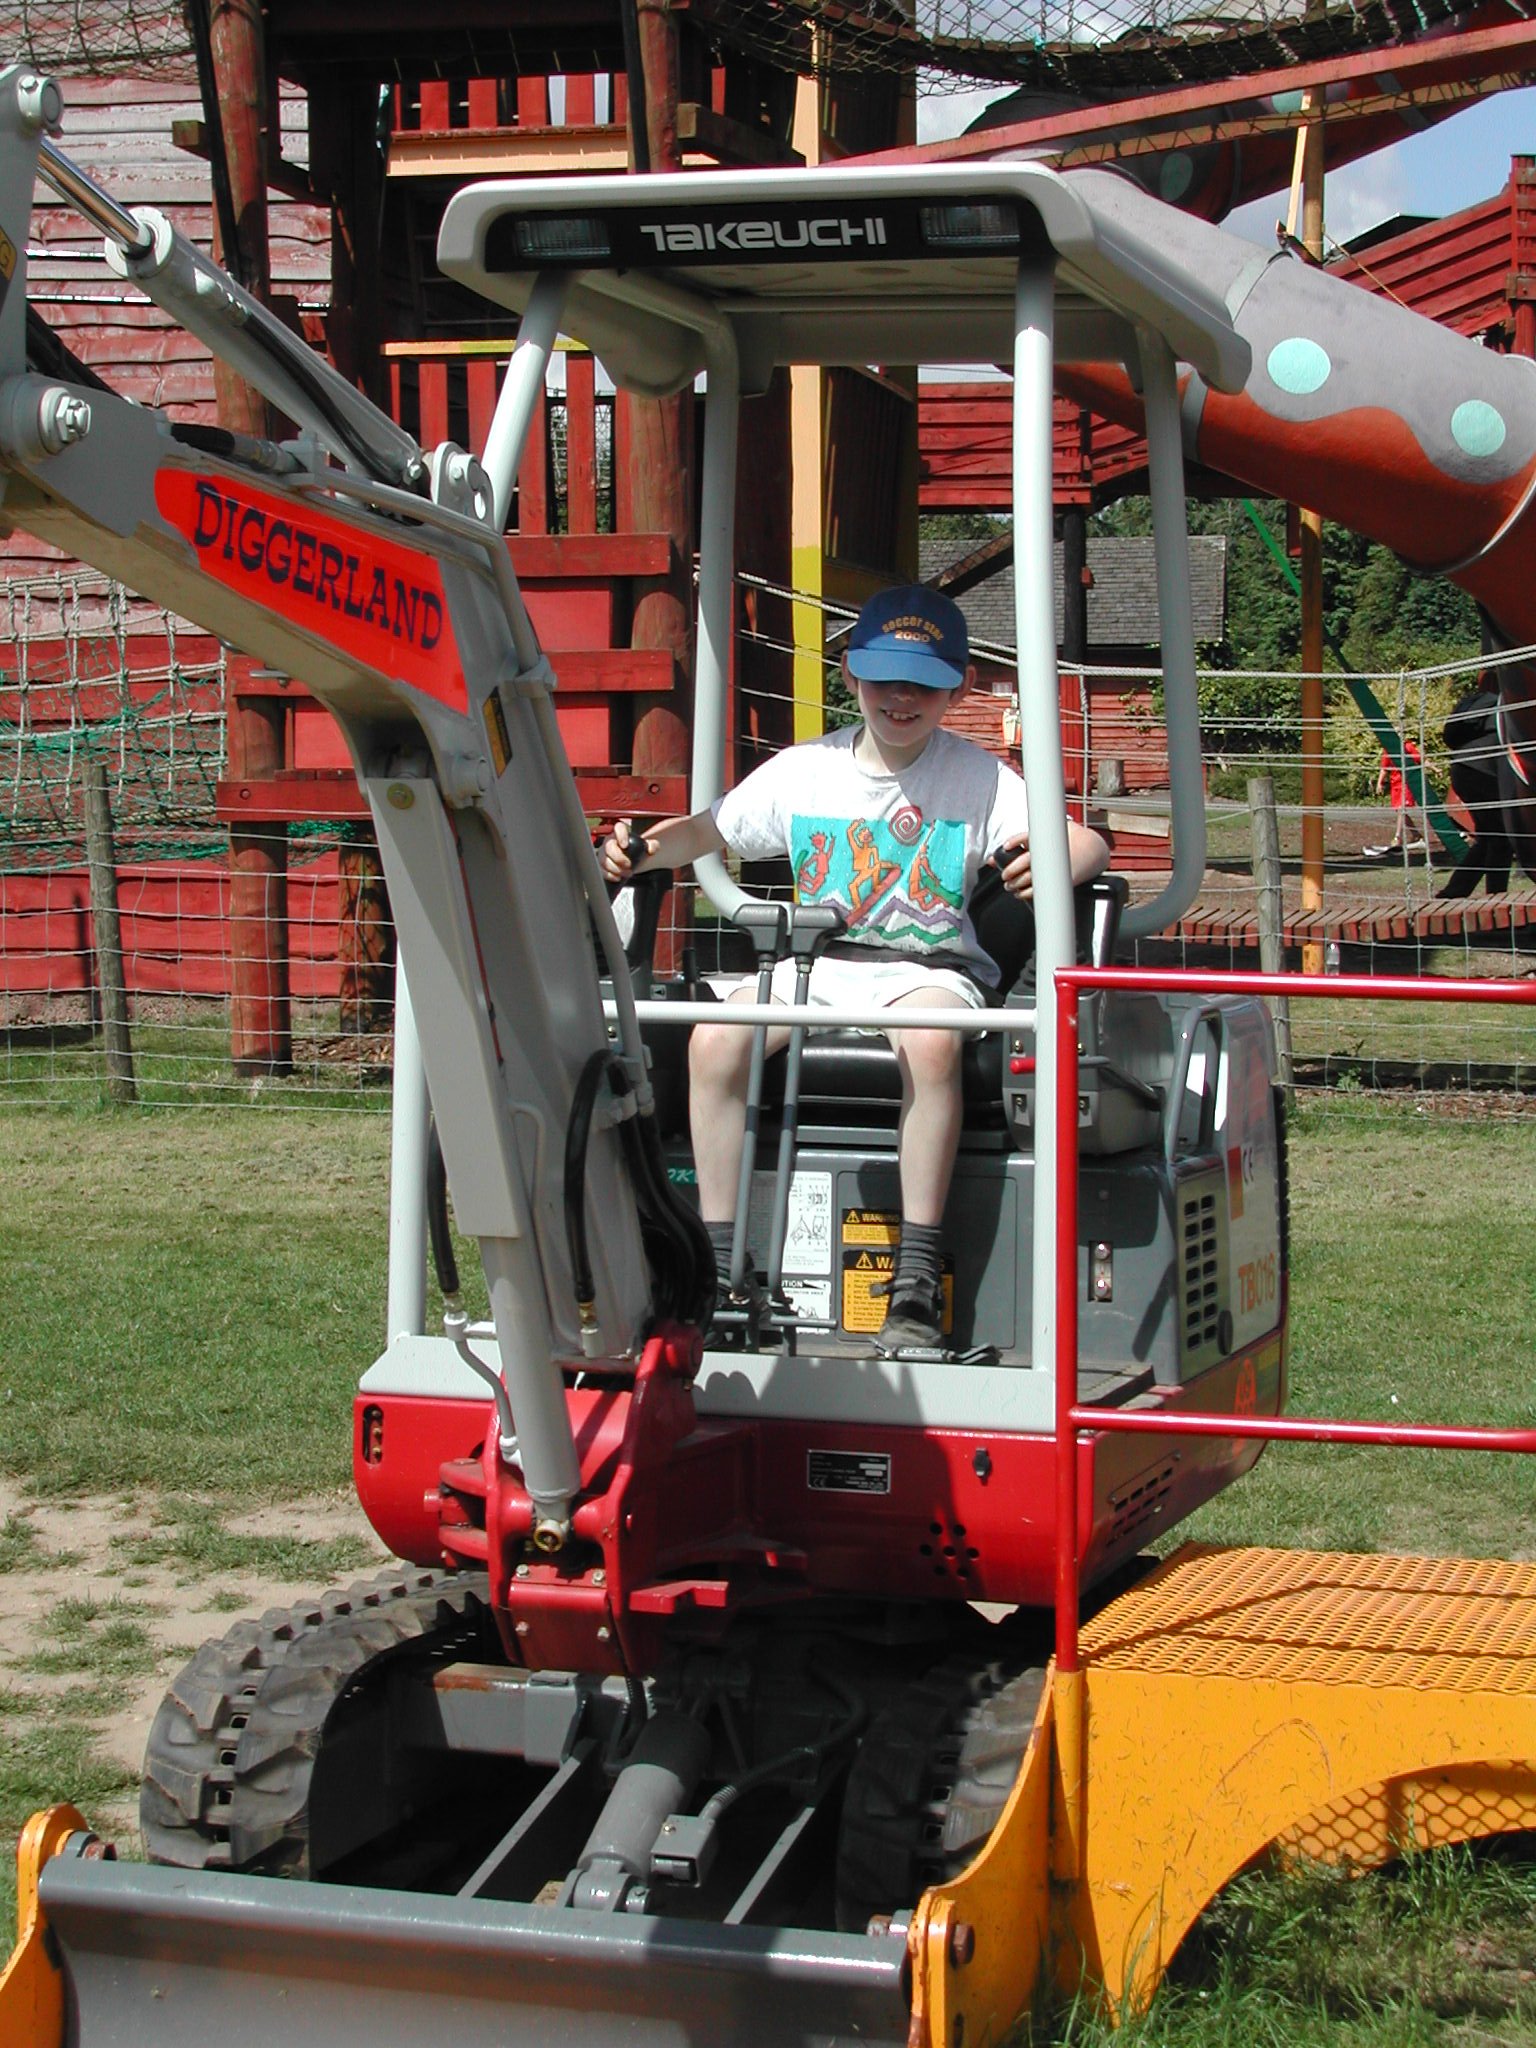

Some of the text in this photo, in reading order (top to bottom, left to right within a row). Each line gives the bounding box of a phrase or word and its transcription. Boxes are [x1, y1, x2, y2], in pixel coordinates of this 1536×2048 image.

[193, 480, 443, 651] DIGGERLAND
[895, 630, 930, 642] 2000
[1238, 1252, 1276, 1314] TB016
